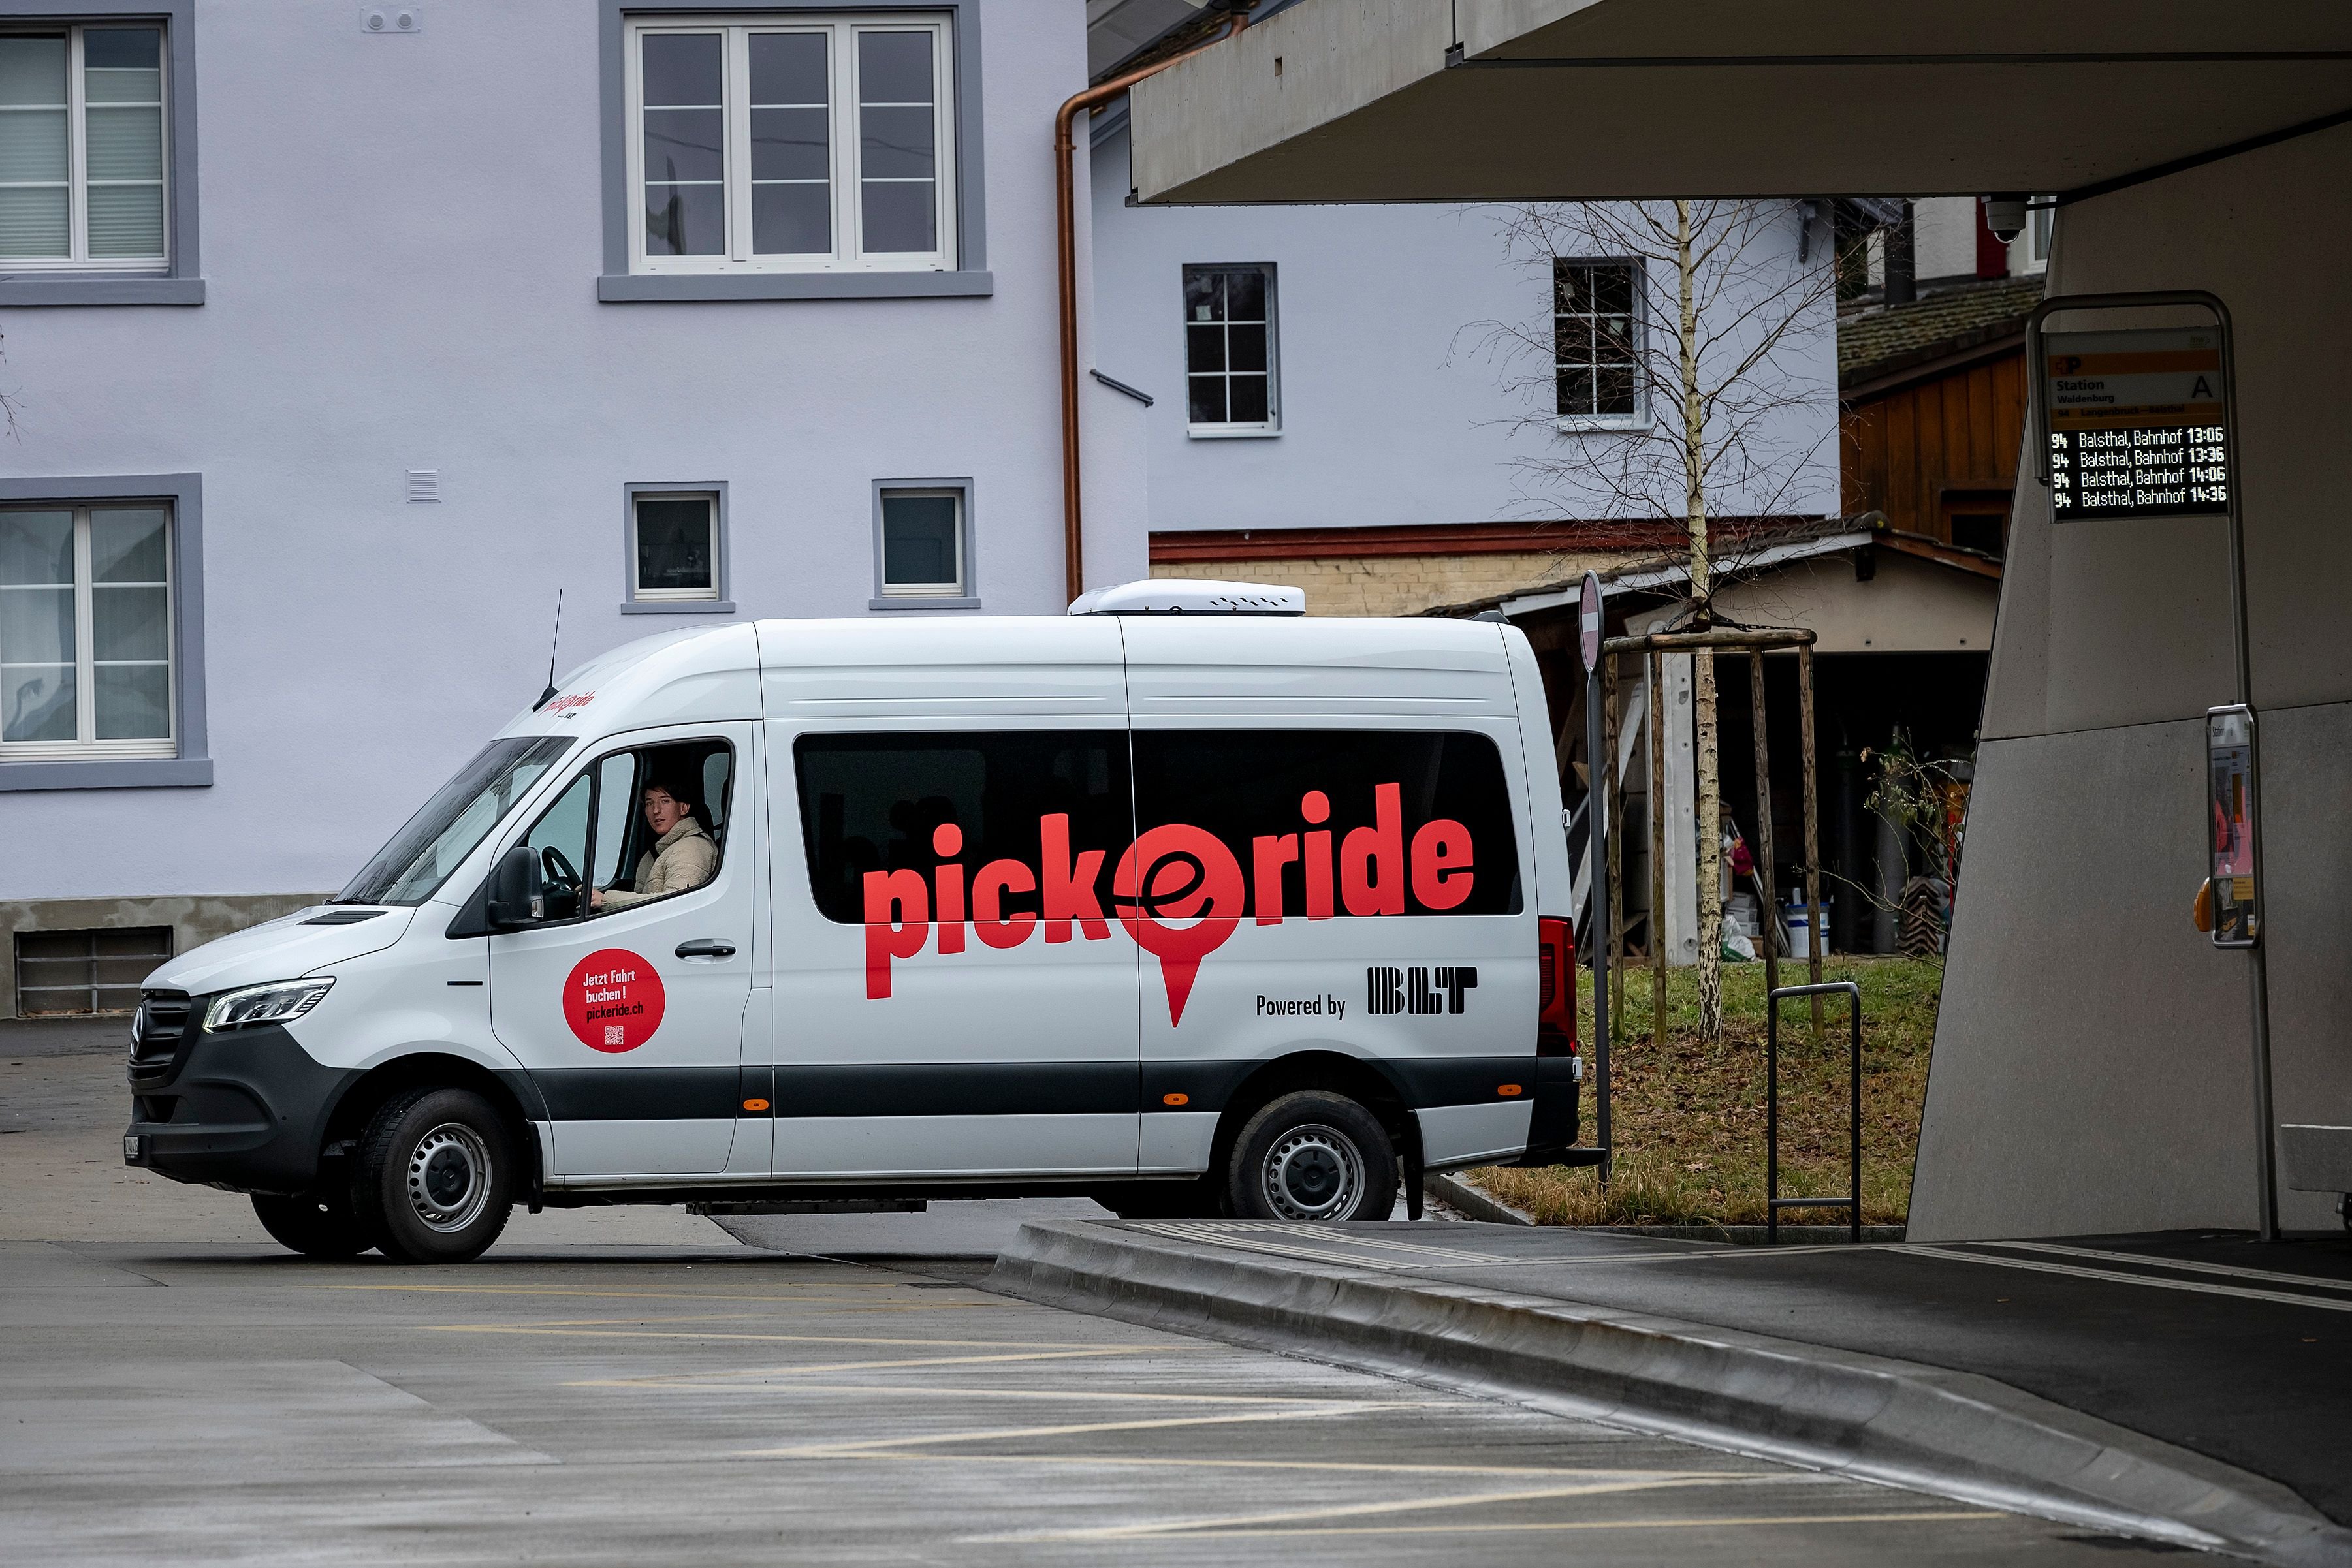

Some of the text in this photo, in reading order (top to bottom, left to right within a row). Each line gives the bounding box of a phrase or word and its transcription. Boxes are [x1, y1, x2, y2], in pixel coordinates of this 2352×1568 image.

[2057, 380, 2104, 392] Station
[2191, 376, 2213, 398] A
[2058, 394, 2114, 404] Waldenburg
[2052, 427, 2223, 448] 94 Balsthal, Bahnhof 13:06
[2052, 447, 2225, 468] 94 Balsthal, Bahnhof 13:36
[2054, 466, 2225, 488] 94 Balsthal, Bahnhof 14:06
[2055, 486, 2227, 508] 94 Balsthal, Bahnhof 14:36
[863, 782, 1474, 1028] pickeride
[582, 969, 635, 986] Jetzt Fahrt
[1256, 966, 1478, 1021] Powered by BLT
[586, 1001, 643, 1024] pickeride.ch
